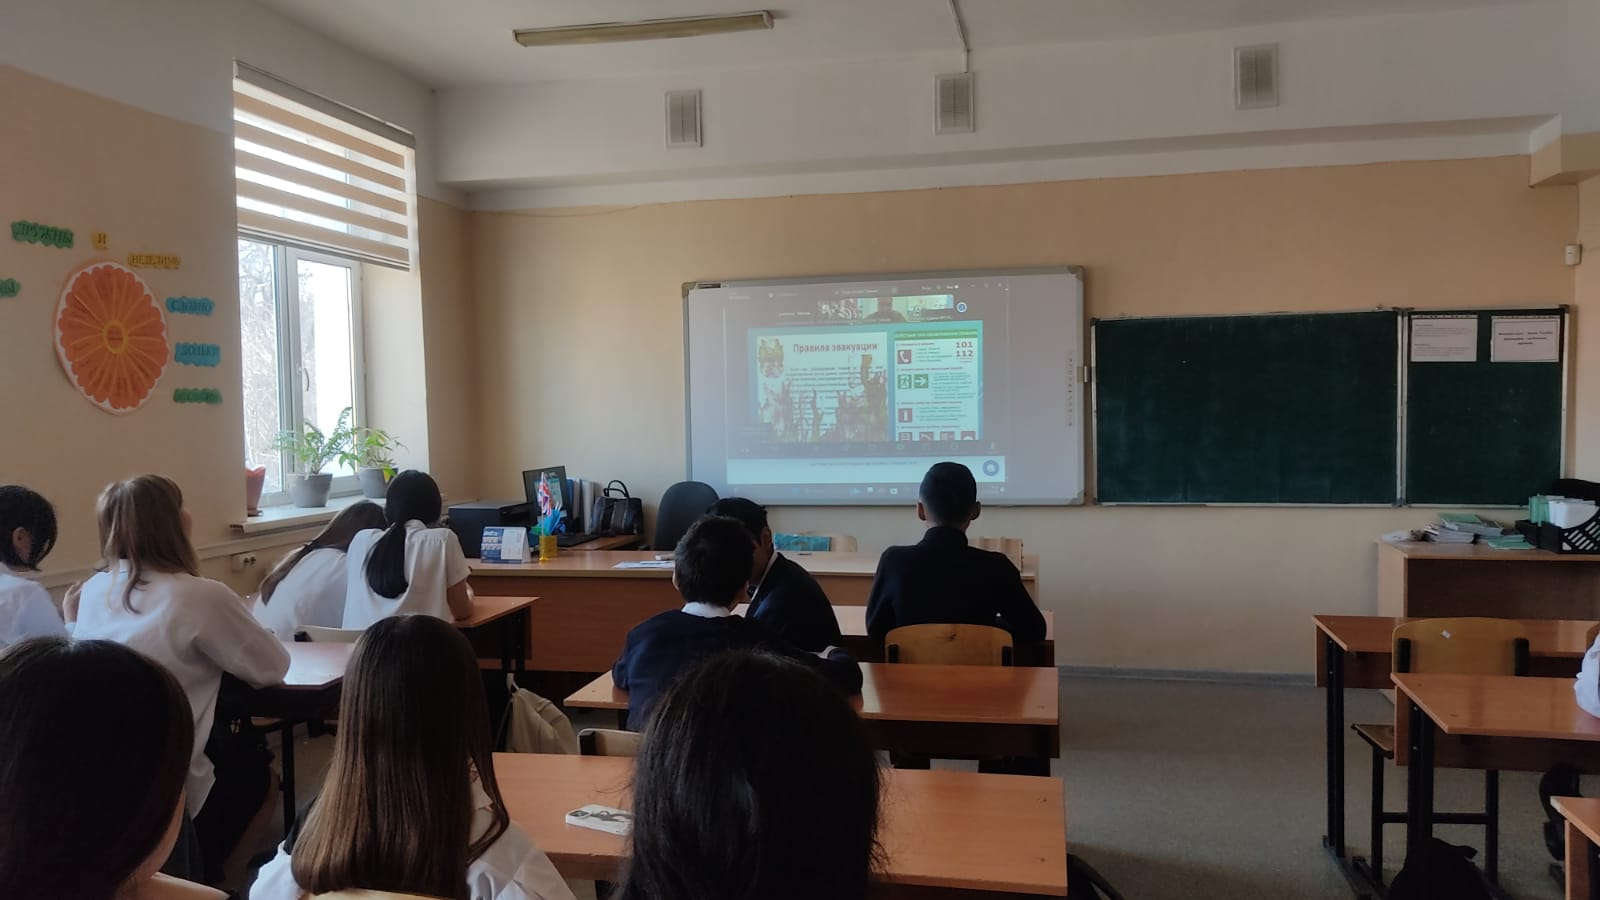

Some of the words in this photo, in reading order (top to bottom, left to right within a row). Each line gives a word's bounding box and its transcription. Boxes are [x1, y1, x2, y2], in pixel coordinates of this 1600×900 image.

[793, 343, 830, 354] Правила
[832, 343, 878, 352] эвакуации
[956, 349, 974, 357] 112
